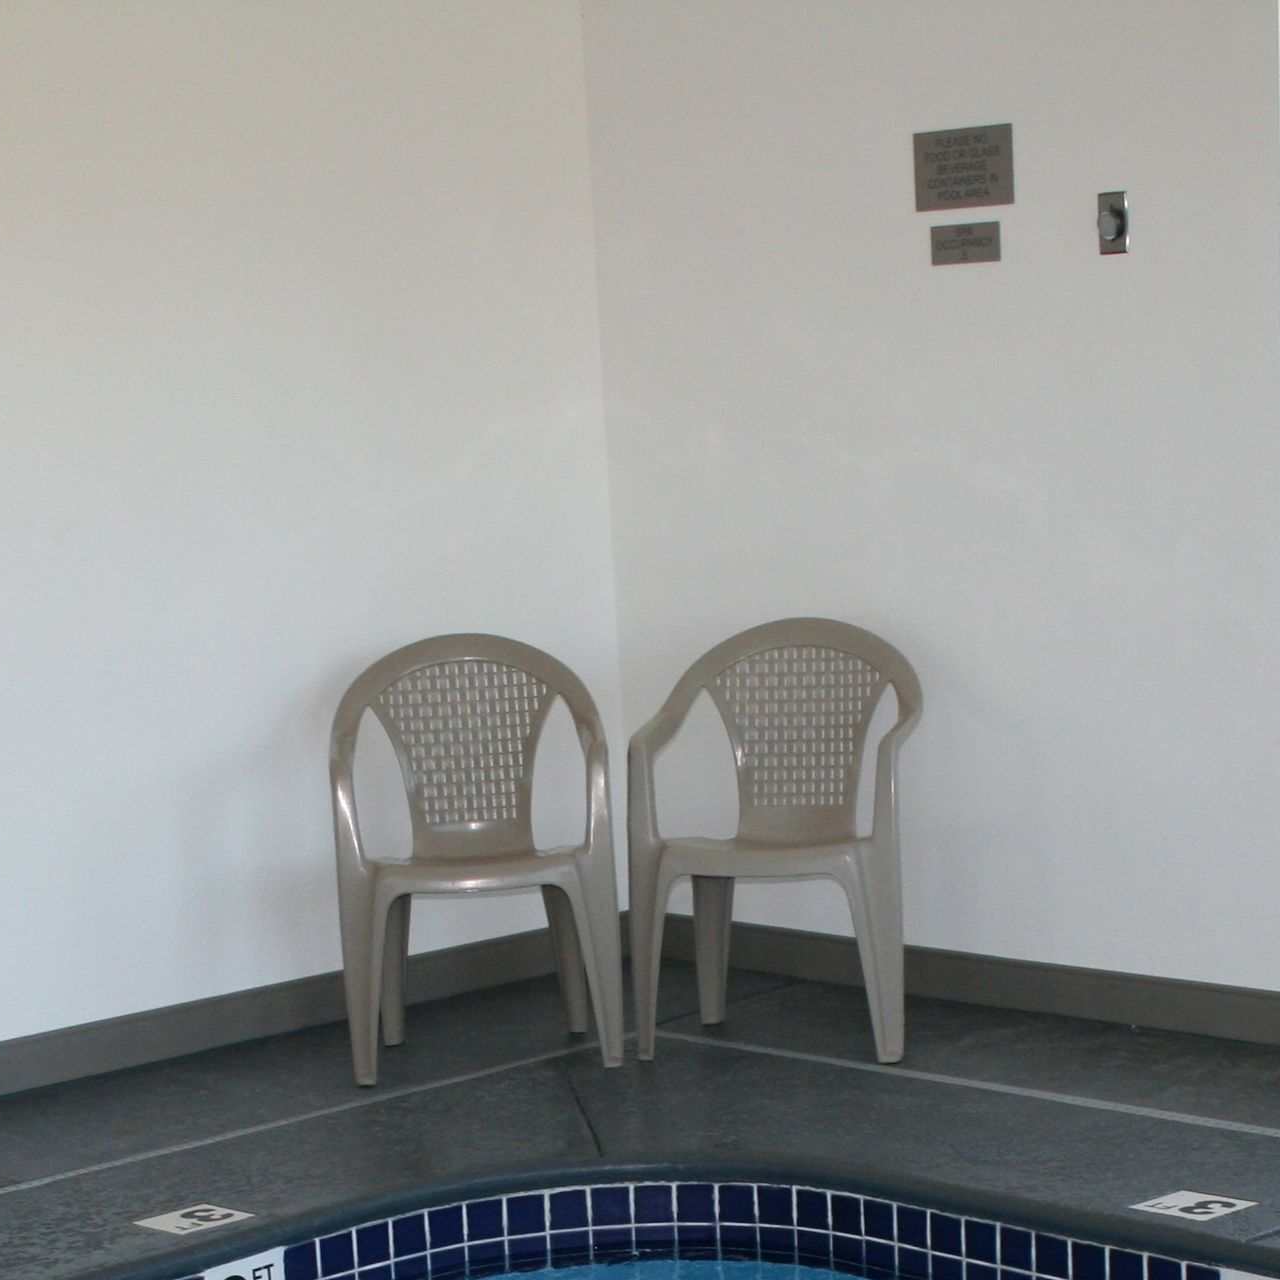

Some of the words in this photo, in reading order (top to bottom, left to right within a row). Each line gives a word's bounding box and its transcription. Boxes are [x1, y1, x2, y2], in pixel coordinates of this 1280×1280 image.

[935, 134, 970, 148] PLEASE
[973, 133, 988, 145] NO
[924, 150, 950, 163] FOOD
[952, 148, 967, 160] OR
[968, 144, 1000, 158] GLASS
[936, 160, 987, 175] BEVERAGE
[927, 174, 986, 190] CONTAINERS
[989, 173, 1000, 183] IN
[937, 190, 963, 201] POOL
[964, 187, 990, 199] AREA
[936, 236, 993, 251] OCCUPANCY
[1143, 1201, 1179, 1211] FT
[1178, 1200, 1237, 1215] 3
[179, 1208, 235, 1222] 3
[175, 1221, 203, 1232] FT
